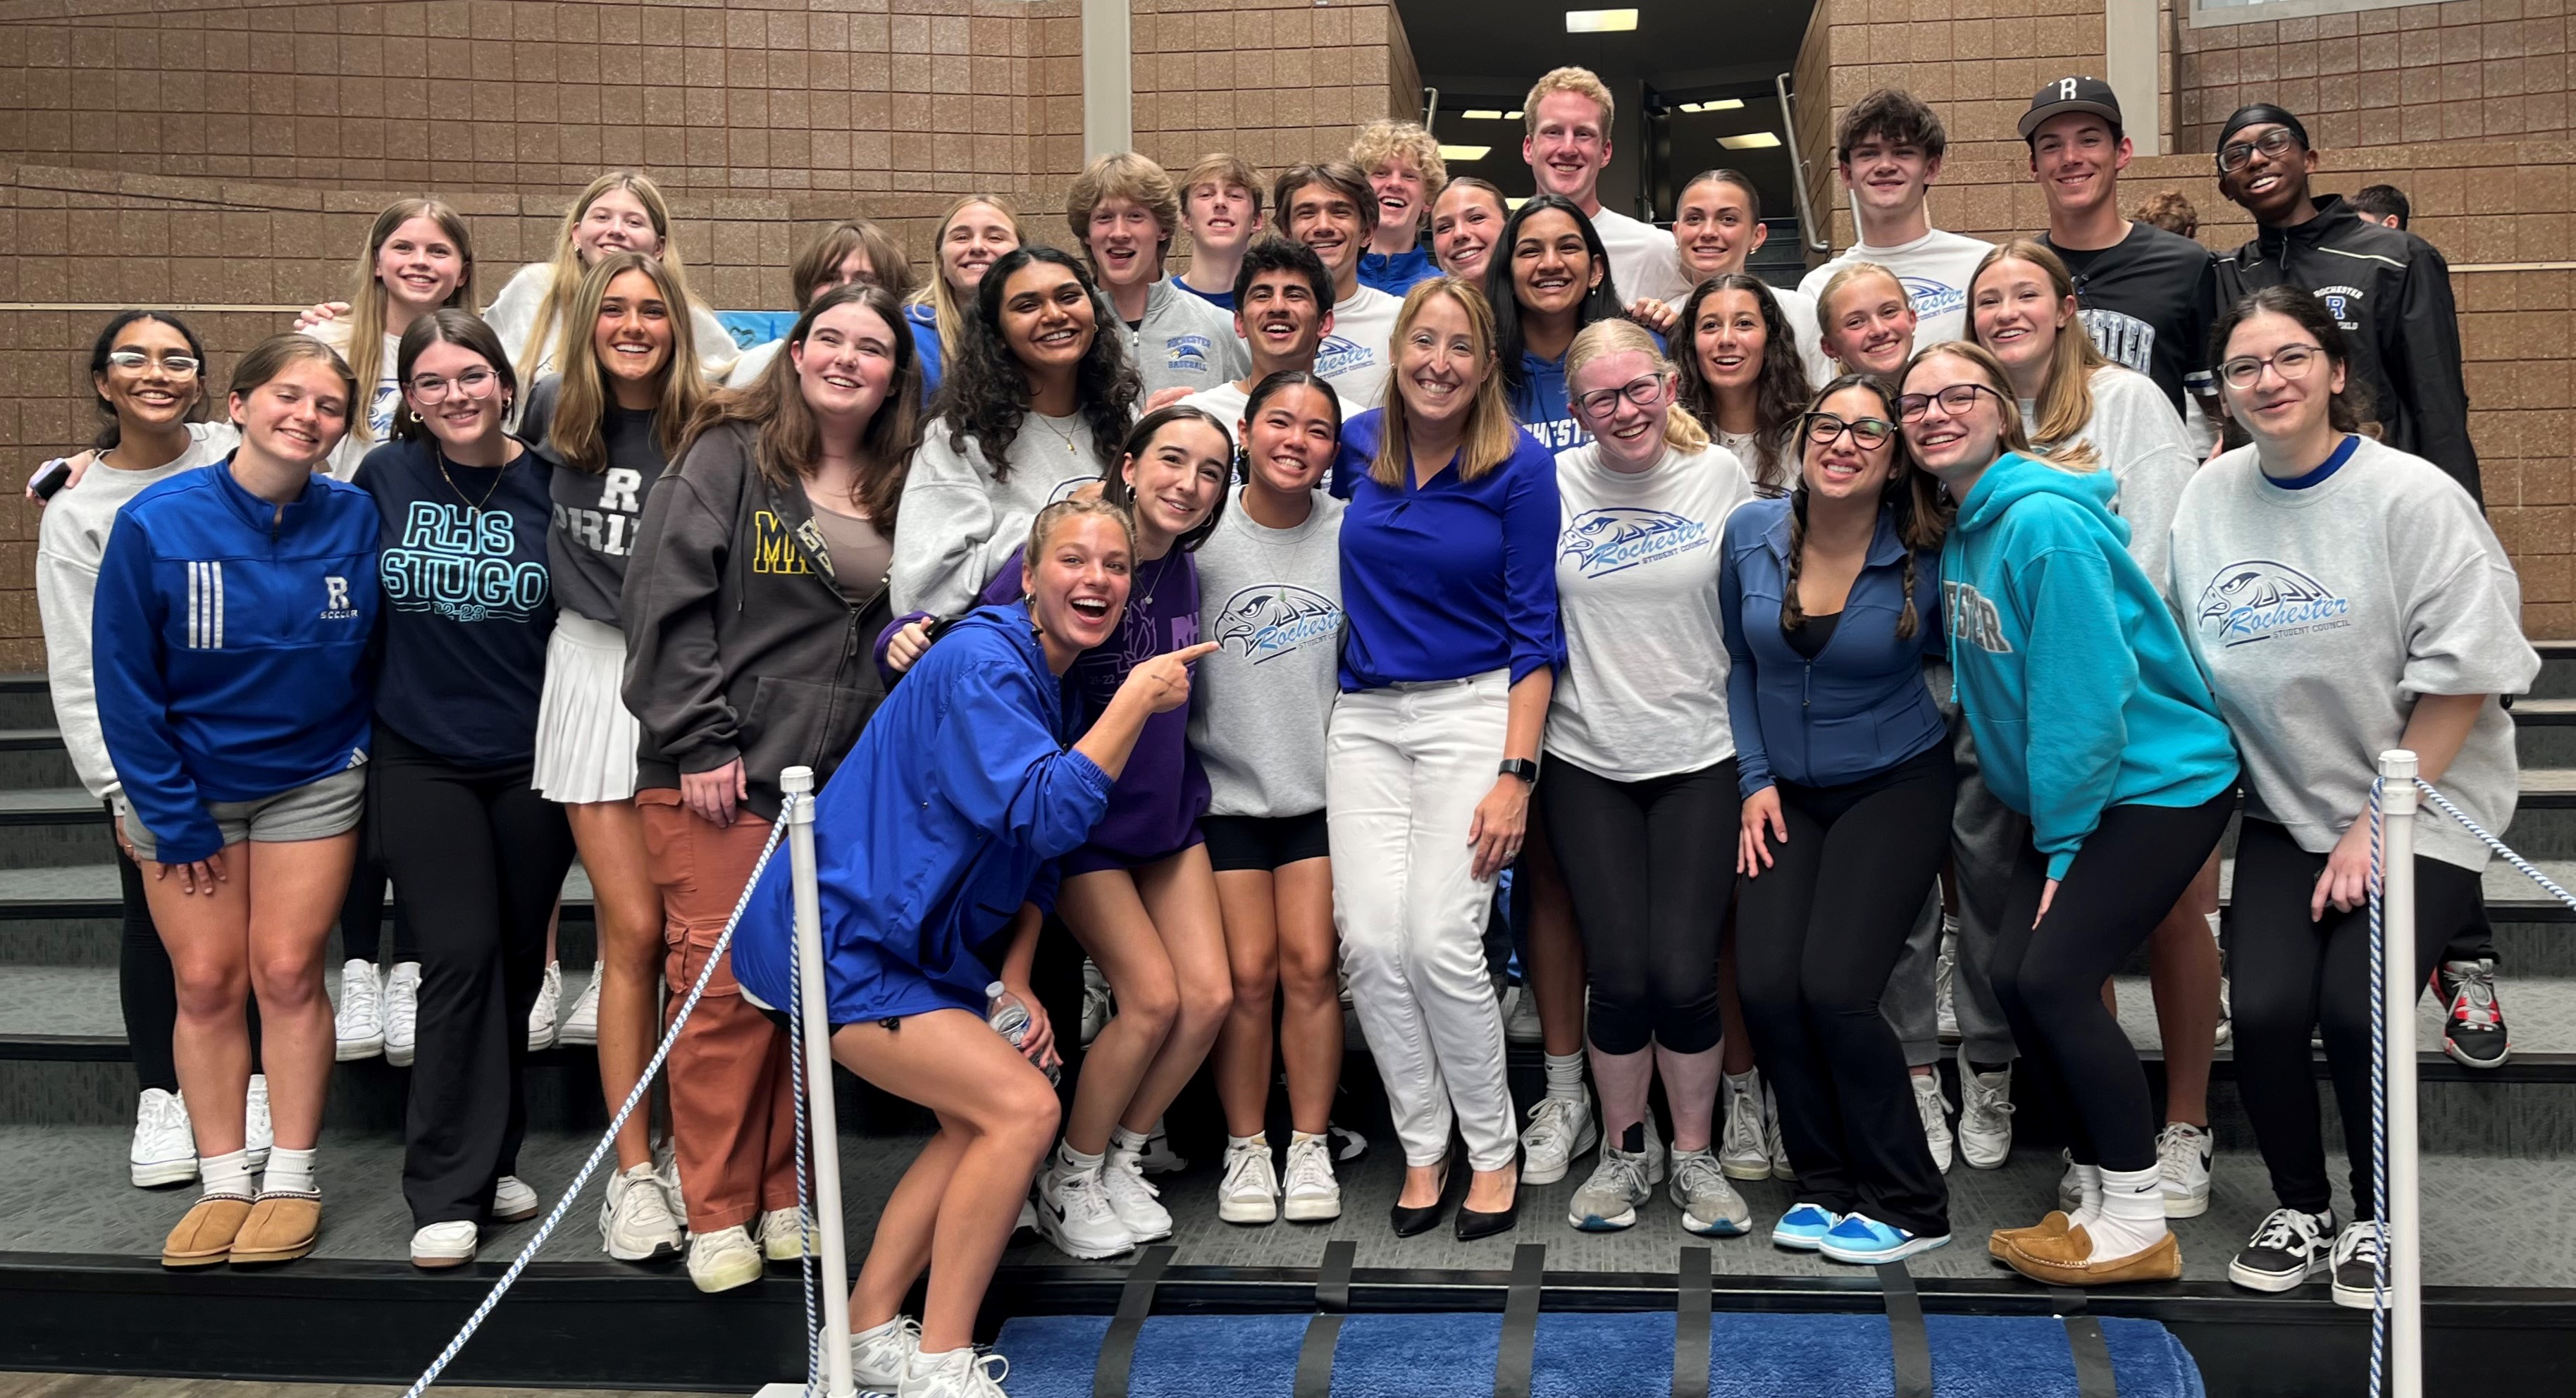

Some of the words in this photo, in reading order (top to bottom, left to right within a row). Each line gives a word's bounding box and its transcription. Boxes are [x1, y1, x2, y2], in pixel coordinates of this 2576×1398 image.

[2058, 77, 2077, 100] R
[2313, 285, 2363, 299] ROCHESTER
[2326, 296, 2346, 320] R
[598, 467, 643, 513] R
[402, 500, 516, 557] RHS
[1592, 521, 1706, 569] Rochester
[1642, 548, 1678, 564] STUDENT
[325, 575, 350, 610] R
[380, 548, 549, 611] STUGO
[2229, 595, 2349, 638] Rochester
[2273, 626, 2310, 638] STUDENT
[2312, 619, 2352, 632] COUNCIL
